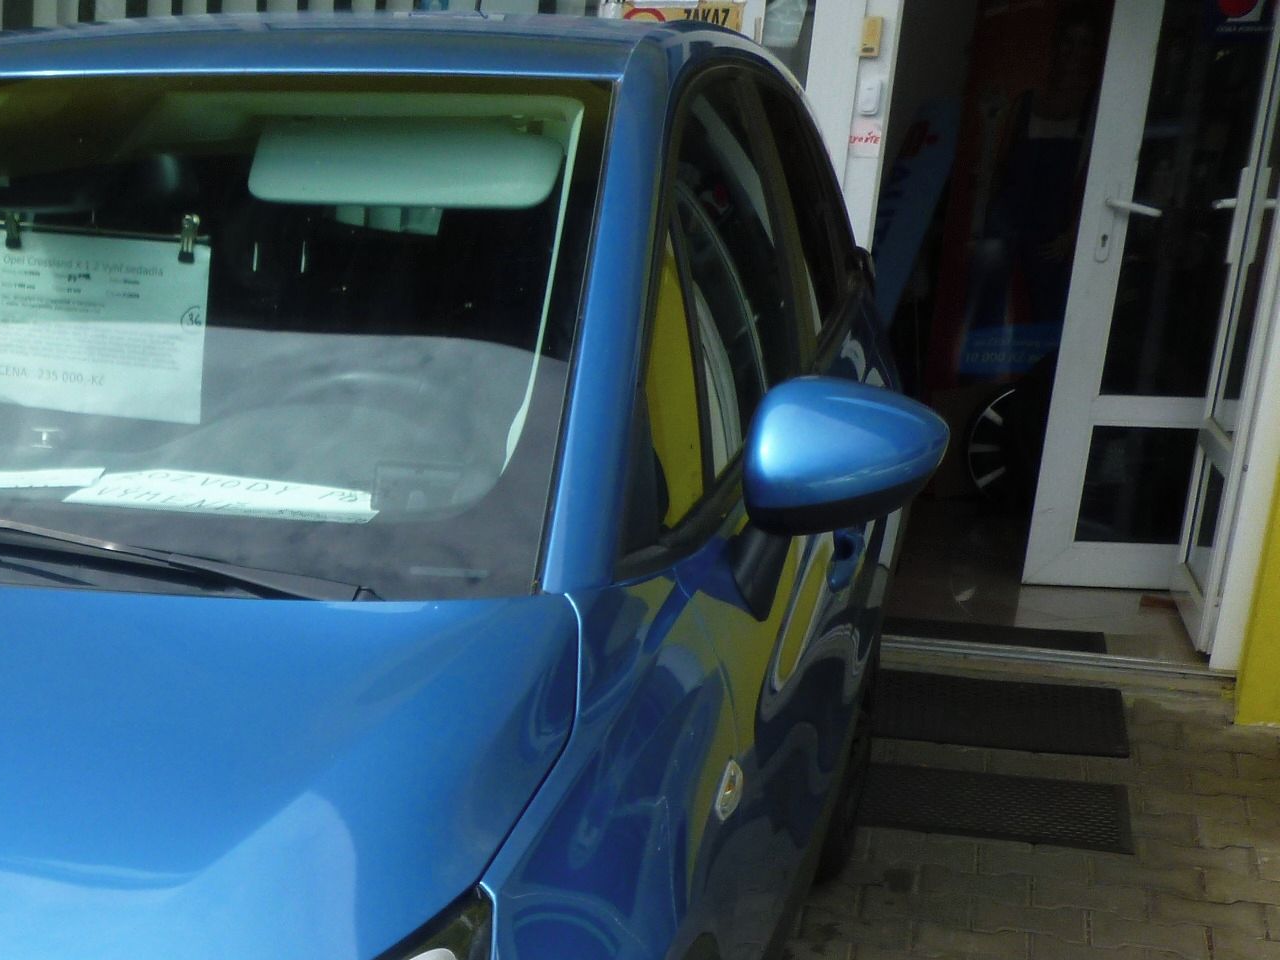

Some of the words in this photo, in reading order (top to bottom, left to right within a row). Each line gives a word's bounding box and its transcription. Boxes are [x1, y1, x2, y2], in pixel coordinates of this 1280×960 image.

[3, 255, 25, 267] Opel
[27, 256, 72, 269] Crossland
[37, 367, 58, 381] 235
